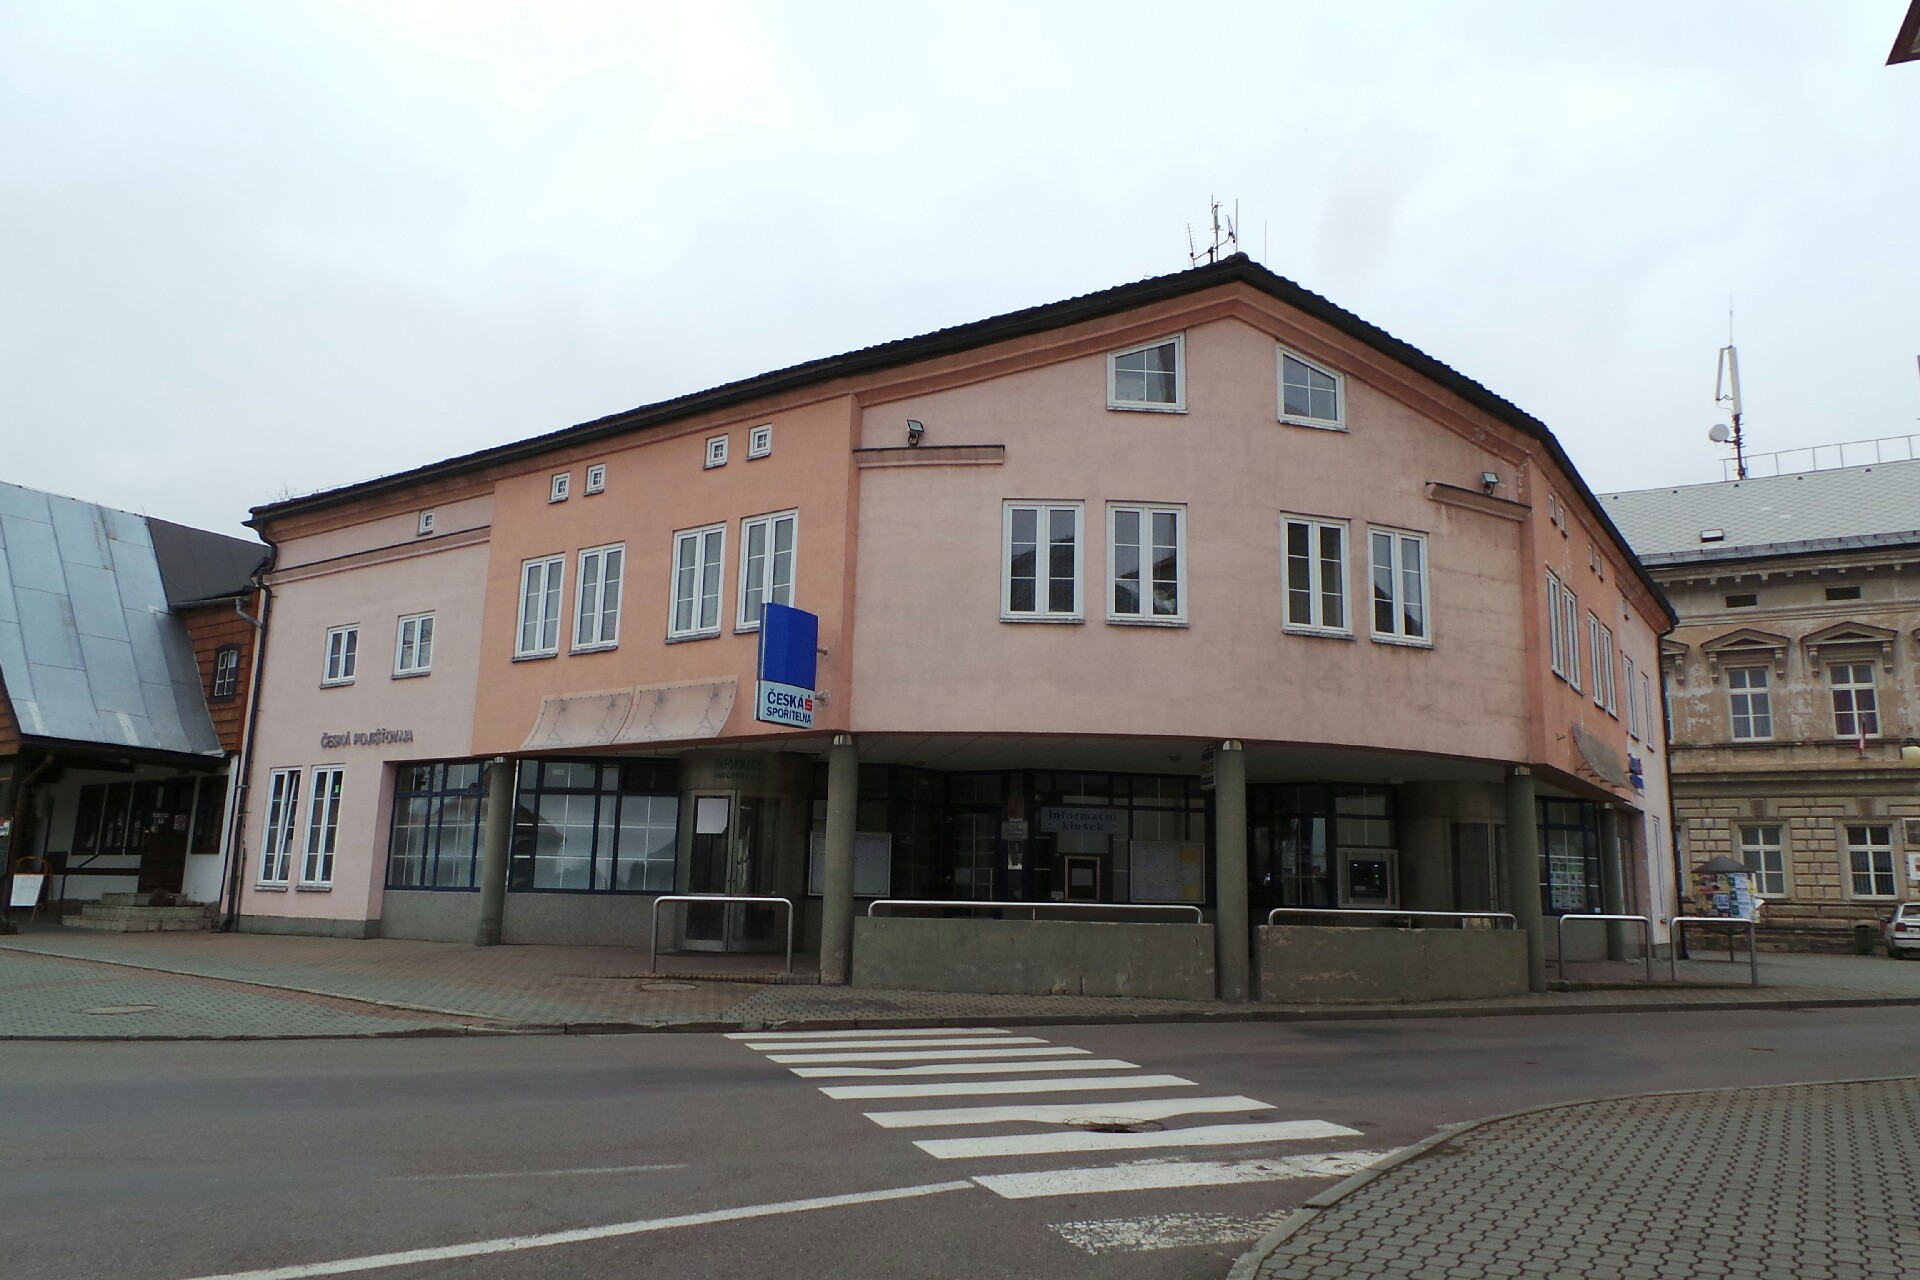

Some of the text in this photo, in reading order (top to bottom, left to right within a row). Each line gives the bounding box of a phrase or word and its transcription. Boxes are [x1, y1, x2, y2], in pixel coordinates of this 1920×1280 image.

[768, 688, 804, 710] ČESKÁ
[766, 706, 812, 724] SPOŘITELNA
[321, 731, 351, 748] ČESKÁ
